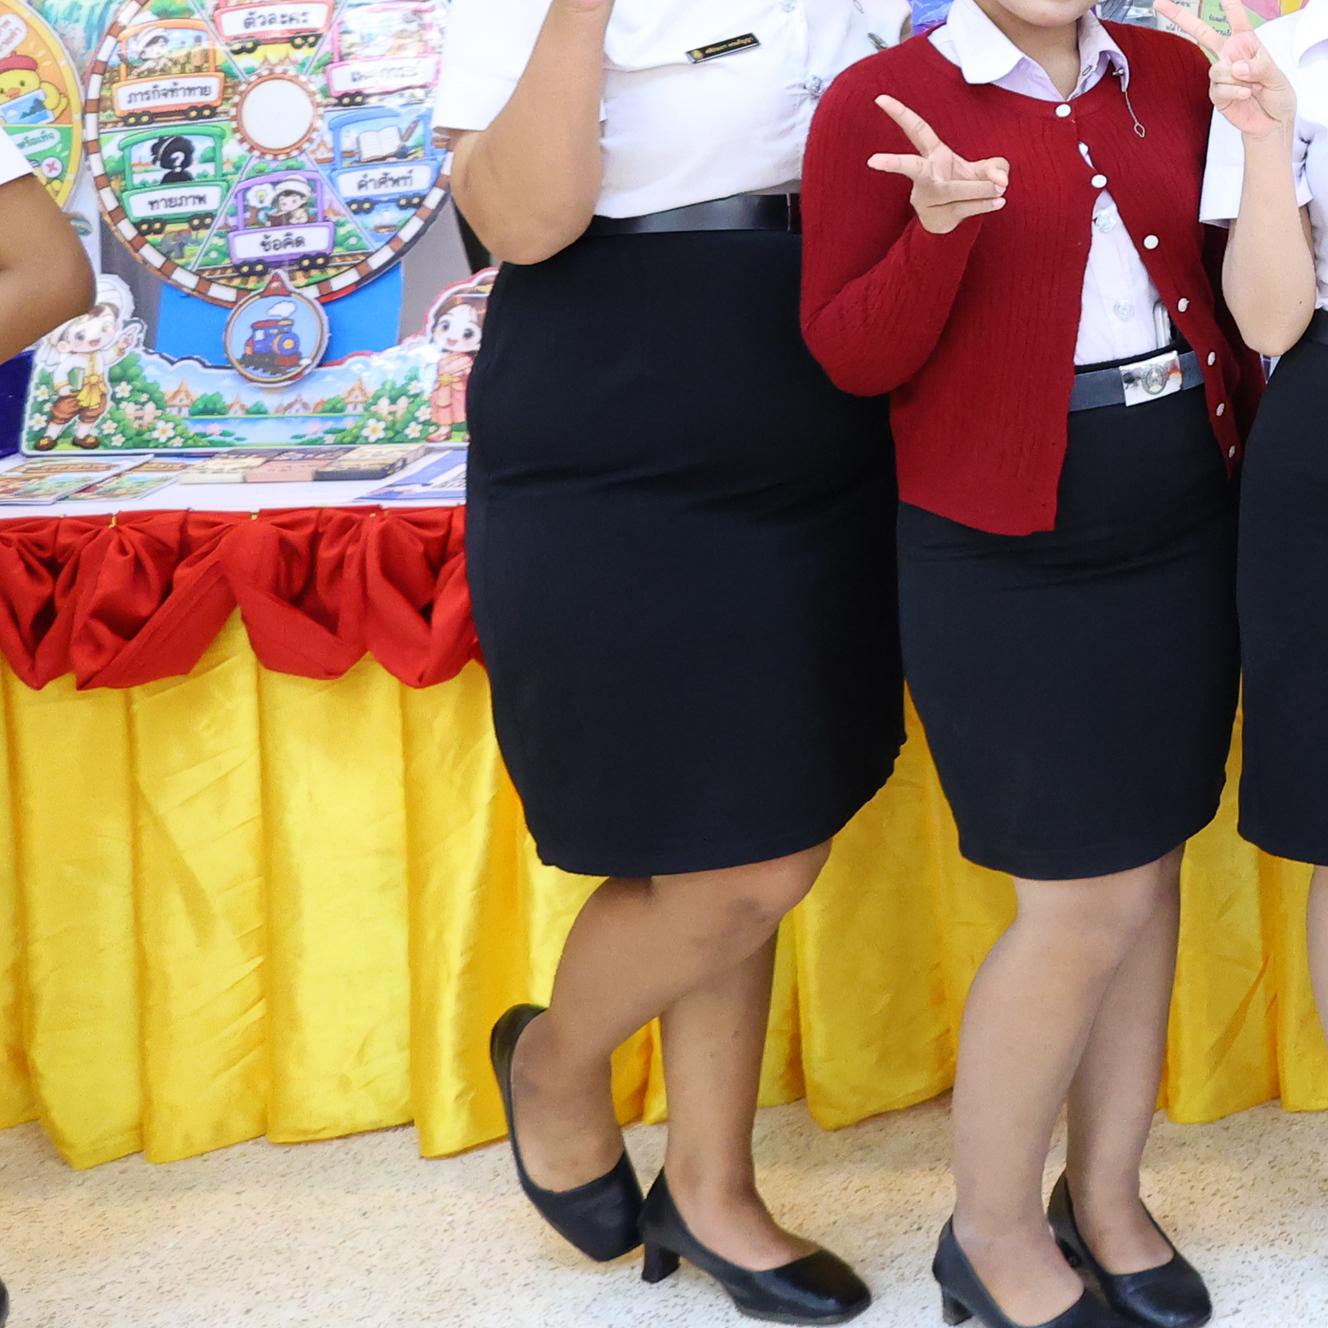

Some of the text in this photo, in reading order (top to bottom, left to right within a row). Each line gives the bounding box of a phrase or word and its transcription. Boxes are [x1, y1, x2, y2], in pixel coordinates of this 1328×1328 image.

[243, 10, 309, 30] ตัวละคร
[127, 82, 213, 104] ภารกิจท้าทาย
[357, 168, 413, 191] คำศัพท์
[147, 193, 207, 211] ทายภาพ
[258, 230, 306, 252] ข้อคิด
